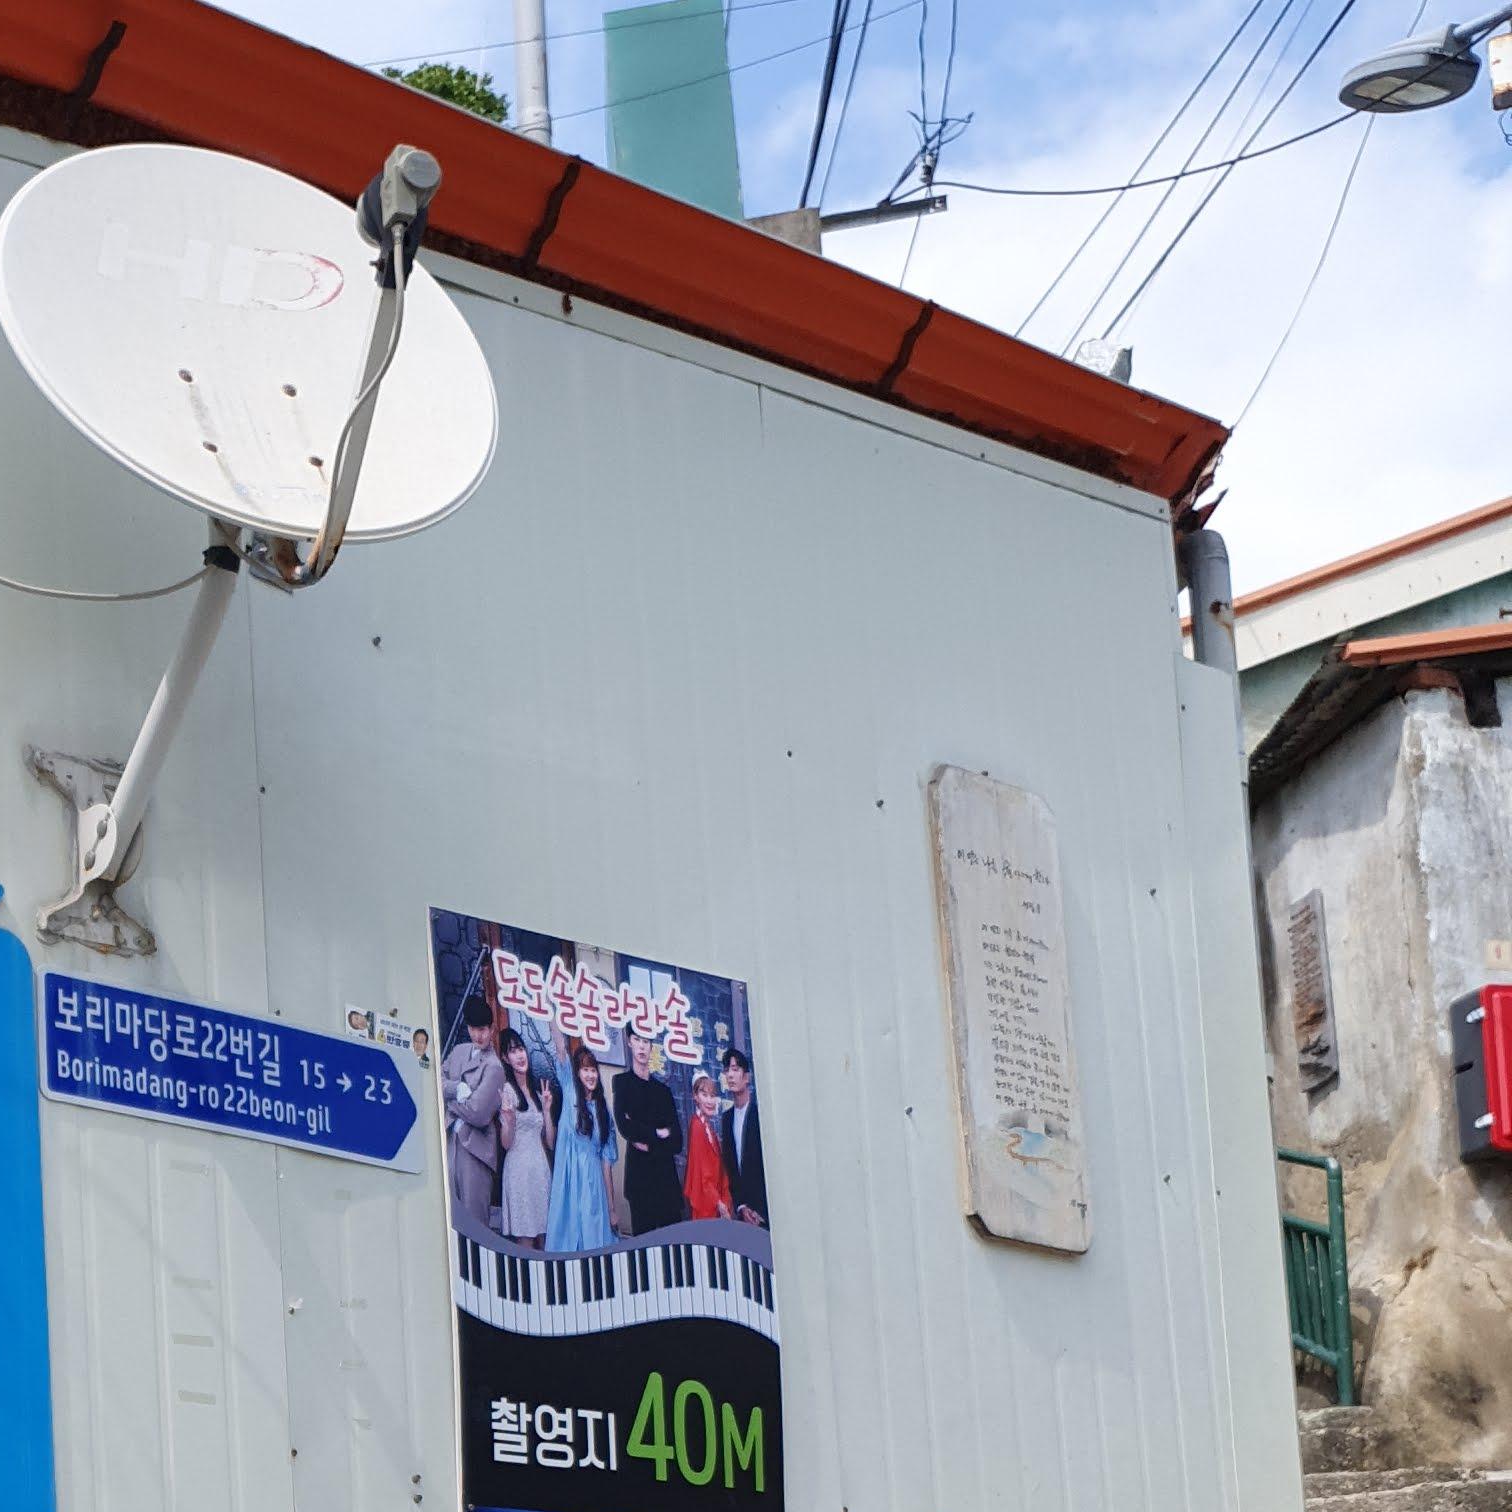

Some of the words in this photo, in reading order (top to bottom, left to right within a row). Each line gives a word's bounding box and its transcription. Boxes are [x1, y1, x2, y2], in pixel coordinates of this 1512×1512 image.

[55, 988, 281, 1087] 보리마당로22번길
[299, 1059, 325, 1089] 15
[364, 1075, 392, 1105] 23
[493, 952, 700, 1063] 도도솔솔라라솔
[57, 1049, 218, 1109] Borimadang-ro
[224, 1084, 331, 1134] 22beon-gil
[490, 1397, 619, 1473] 촬영지
[626, 1371, 767, 1494] 40M
